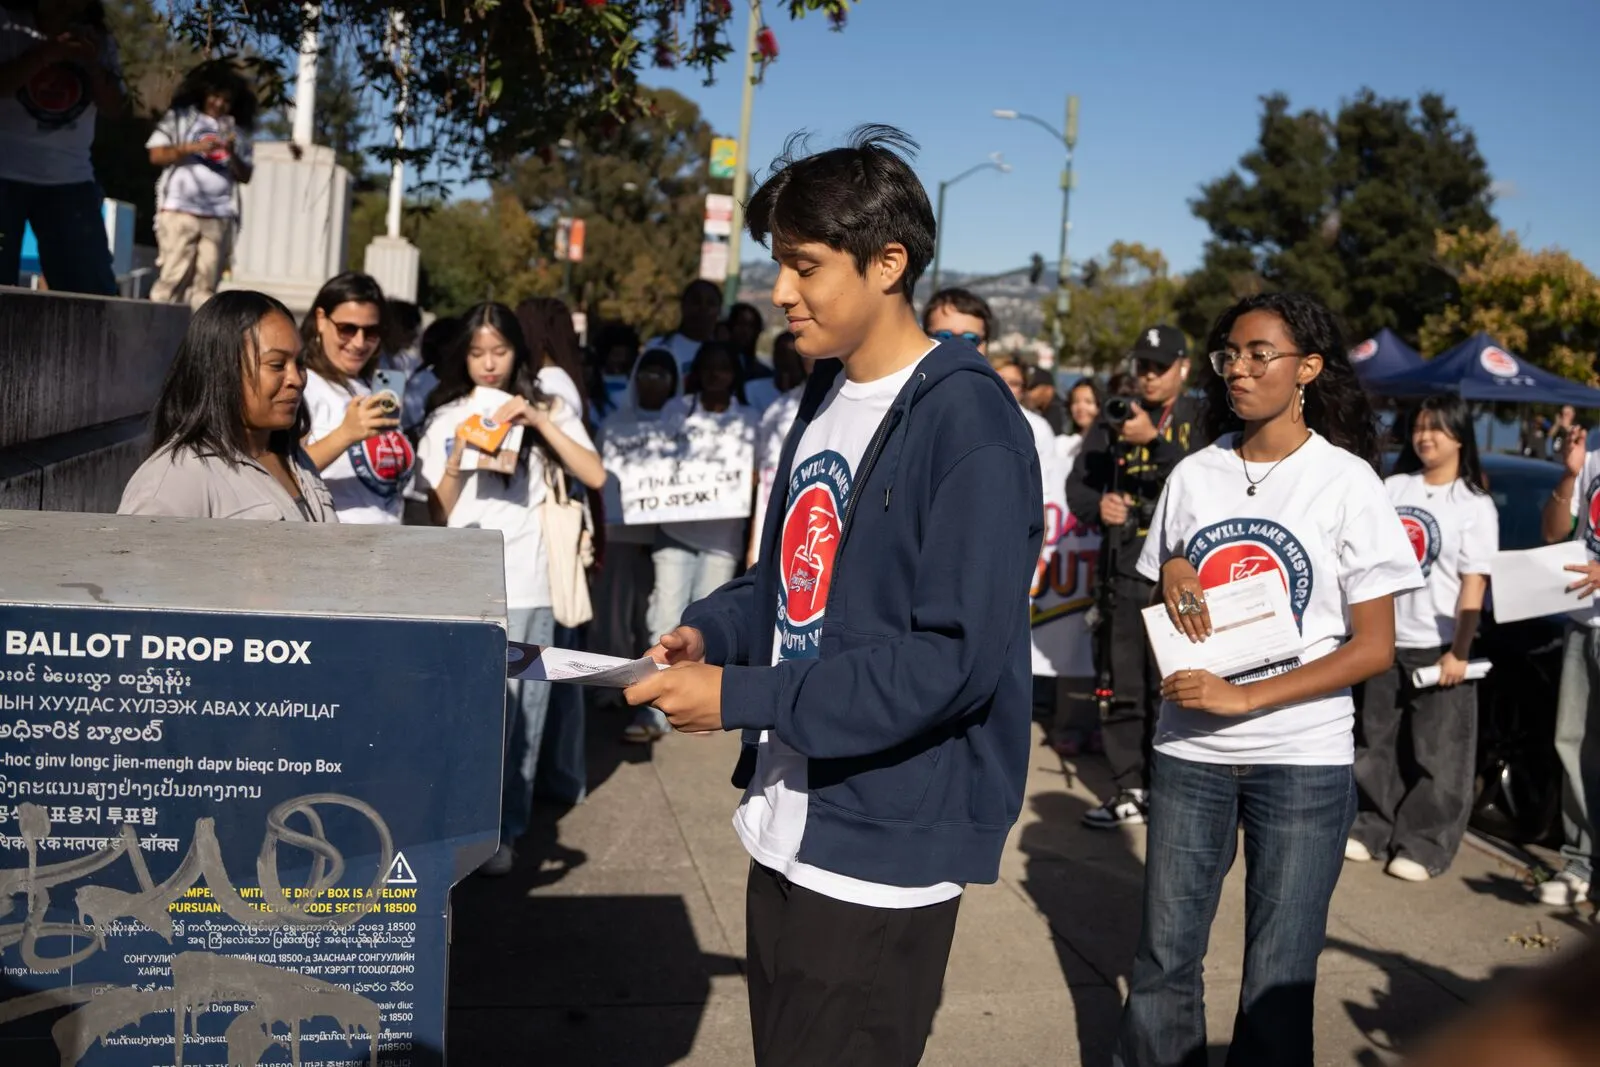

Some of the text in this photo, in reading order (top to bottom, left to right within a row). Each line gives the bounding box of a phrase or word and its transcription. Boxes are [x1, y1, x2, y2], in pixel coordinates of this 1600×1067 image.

[828, 460, 850, 500] MAKE
[637, 498, 659, 511] TO
[1188, 537, 1208, 566] OTE
[1205, 523, 1246, 543] WILL
[1248, 523, 1287, 546] MAKE
[1282, 541, 1311, 609] HISTORY
[5, 630, 312, 665] BALLOT DROP BOX
[39, 695, 115, 716] ХУУДАС
[118, 697, 198, 716] ХҮЛЭЭЖ
[200, 700, 251, 717] АВАХ
[254, 699, 341, 721] ХАЙРЦАГ
[35, 752, 66, 770] ginv
[70, 753, 110, 771] longc
[112, 754, 194, 773] jien-mengh
[197, 756, 233, 774] dapv
[235, 757, 274, 775] bieqc
[277, 758, 312, 776] Drop
[315, 759, 342, 774] Box
[37, 805, 101, 825] 표용지
[106, 806, 159, 826] 투표함
[240, 887, 263, 899] WIT
[327, 888, 350, 899] BOX
[353, 889, 363, 899] IS
[168, 902, 223, 913] PURSUAN
[304, 903, 333, 913] CODE
[384, 903, 417, 913] 18500
[387, 922, 416, 932] 18500
[258, 954, 277, 964] КОД
[312, 953, 357, 962] ЗААСНААР
[358, 951, 416, 962] СОНГУУЛИЙН
[4, 966, 27, 977] fungx
[137, 966, 175, 976] ХАЙРЦГ
[211, 1003, 233, 1014] Drop
[233, 1003, 250, 1013] Box
[389, 1012, 413, 1022] 18500
